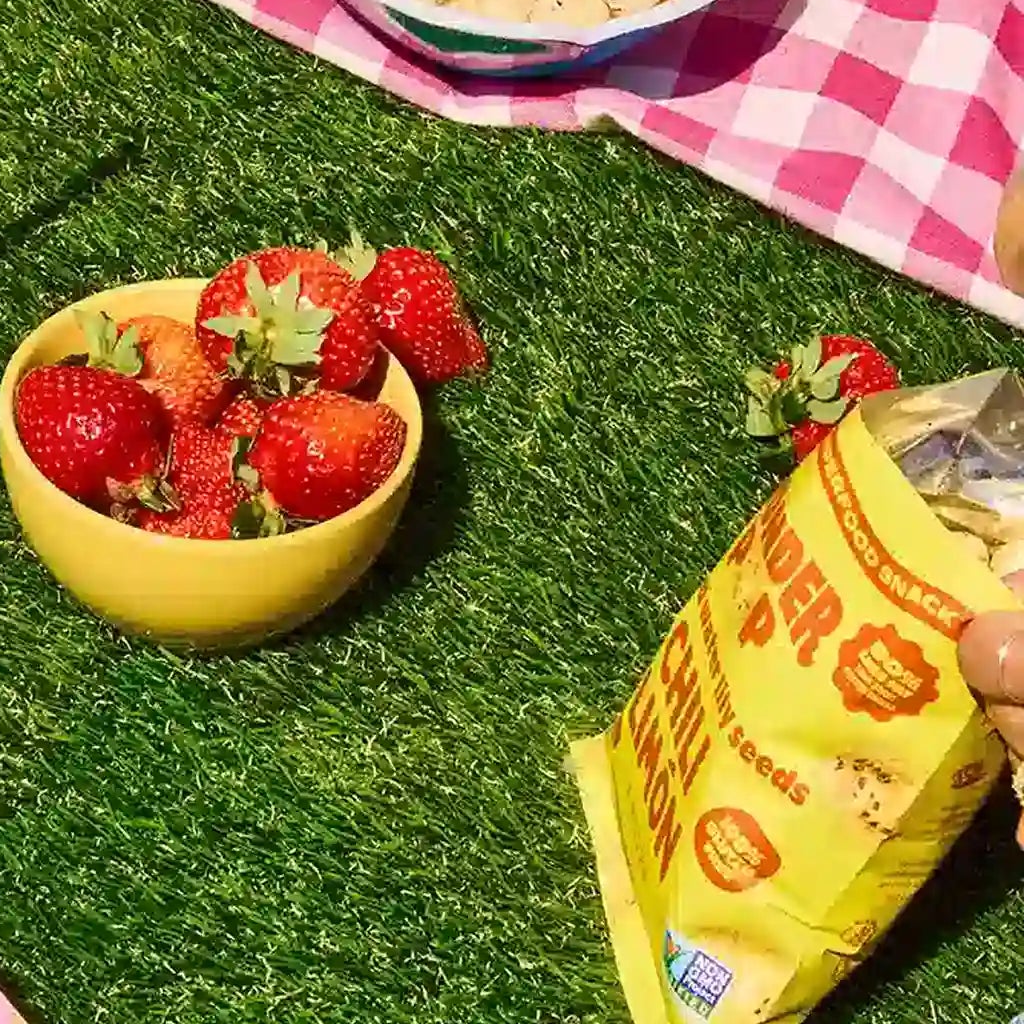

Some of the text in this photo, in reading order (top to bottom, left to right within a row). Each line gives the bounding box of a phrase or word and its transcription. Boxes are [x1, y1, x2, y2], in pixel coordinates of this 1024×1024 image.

[877, 565, 962, 628] SNACK
[660, 620, 712, 798] CHILI
[728, 725, 811, 806] seeds
[688, 966, 723, 996] GMO
[695, 954, 731, 986] NON
